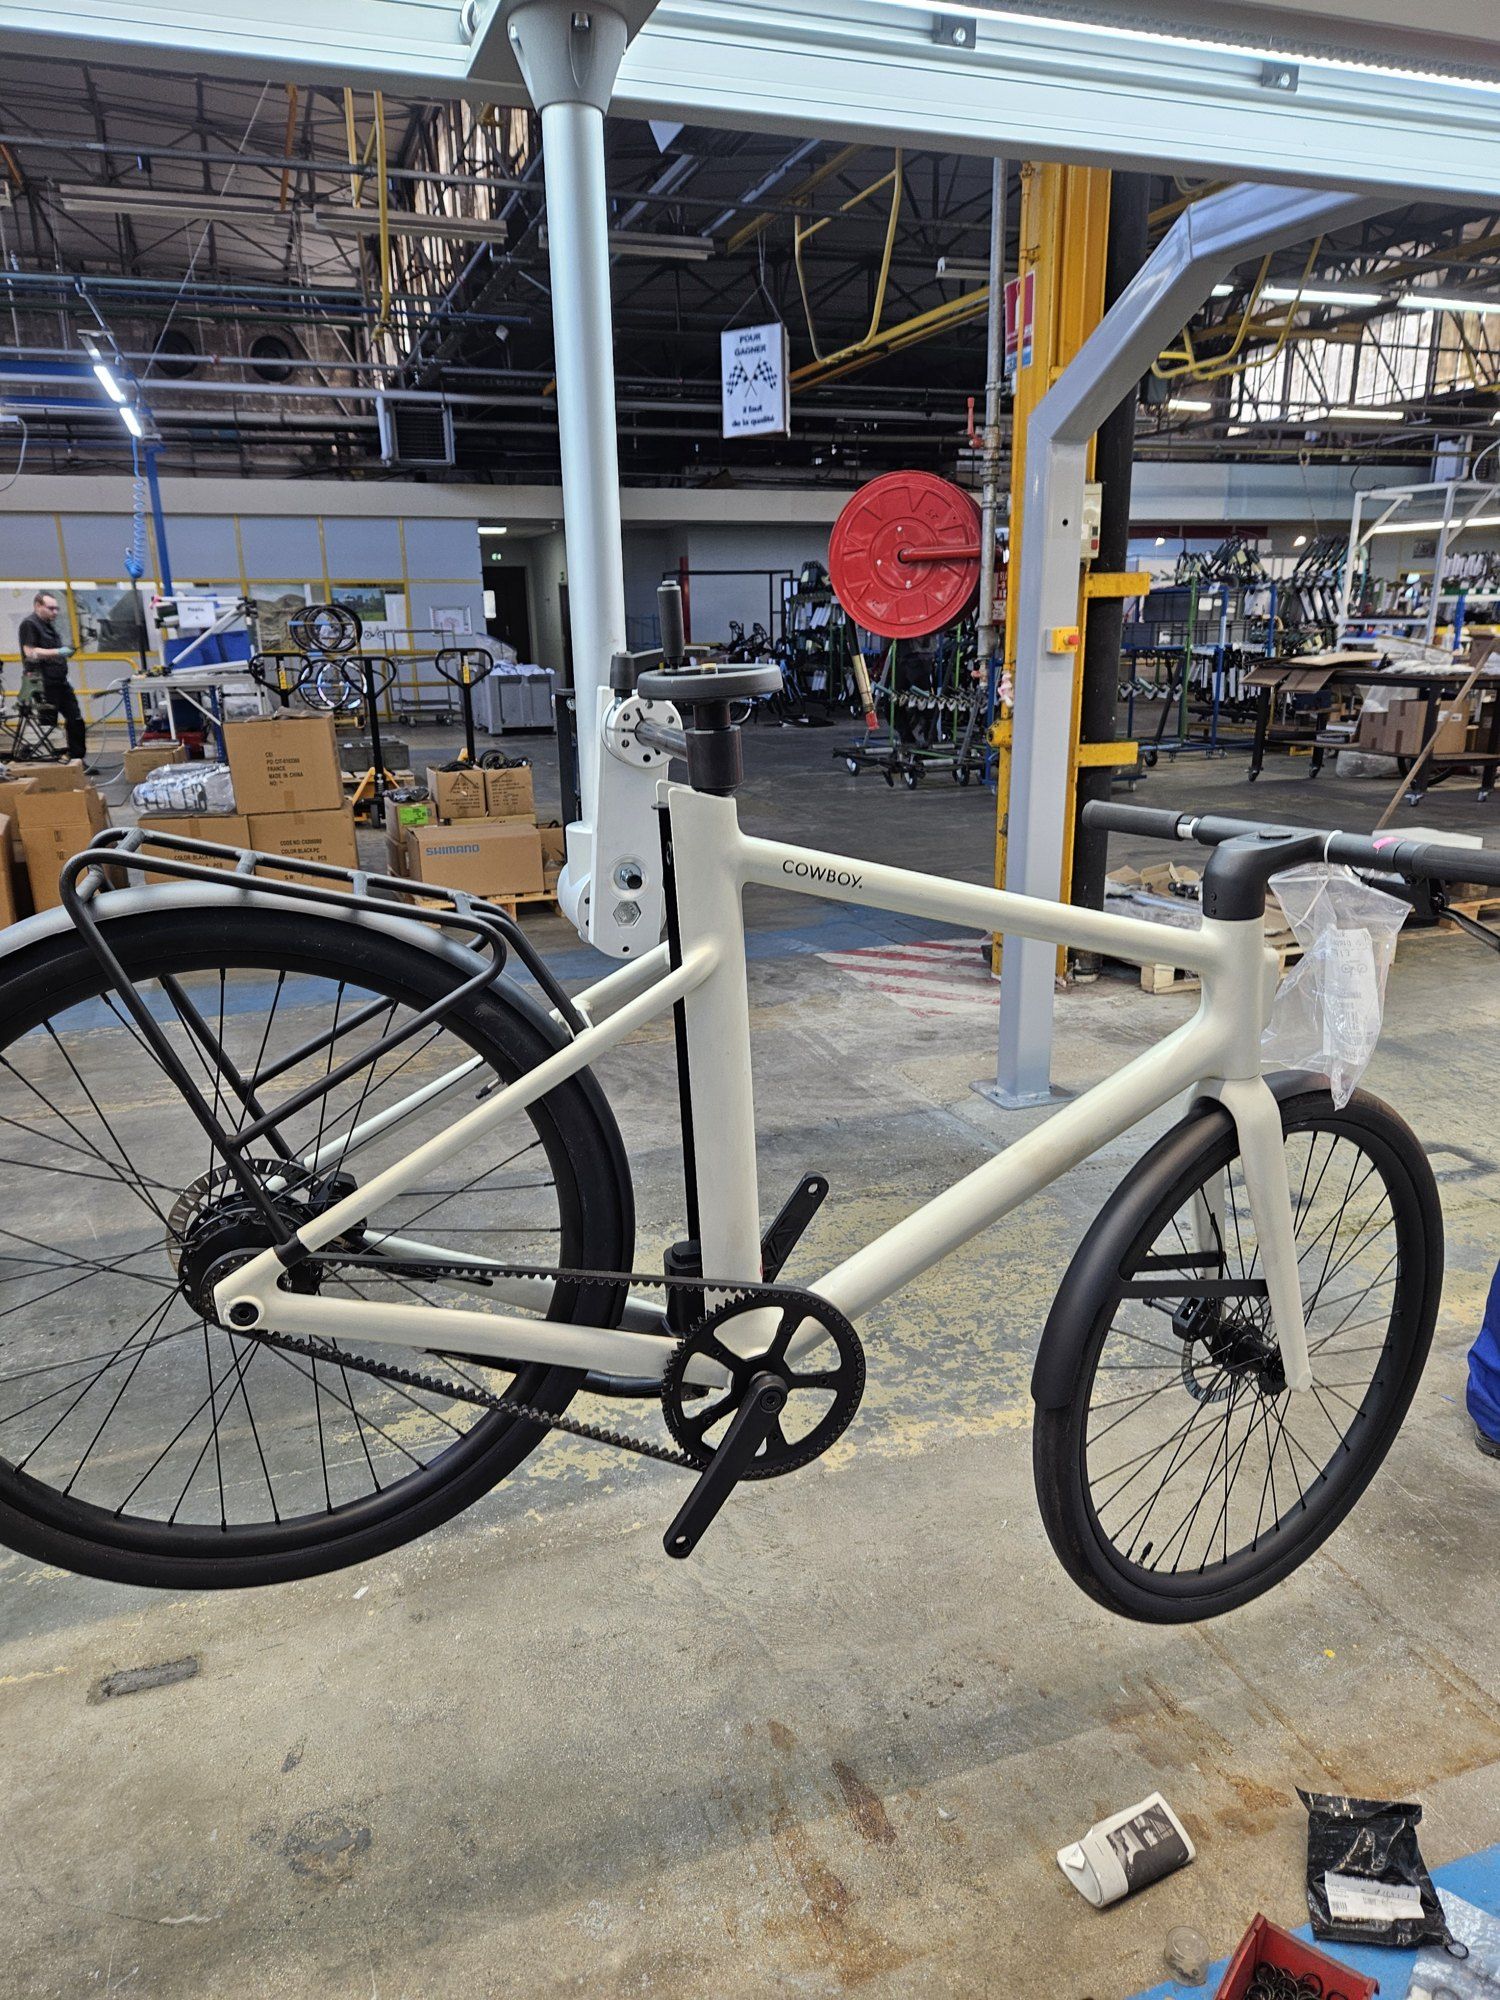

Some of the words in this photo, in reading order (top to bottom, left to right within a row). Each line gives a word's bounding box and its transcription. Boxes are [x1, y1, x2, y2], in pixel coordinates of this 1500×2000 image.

[739, 333, 761, 344] POUR
[734, 344, 767, 357] GAGNER
[750, 415, 775, 427] qualité
[425, 844, 480, 856] SHIMANO
